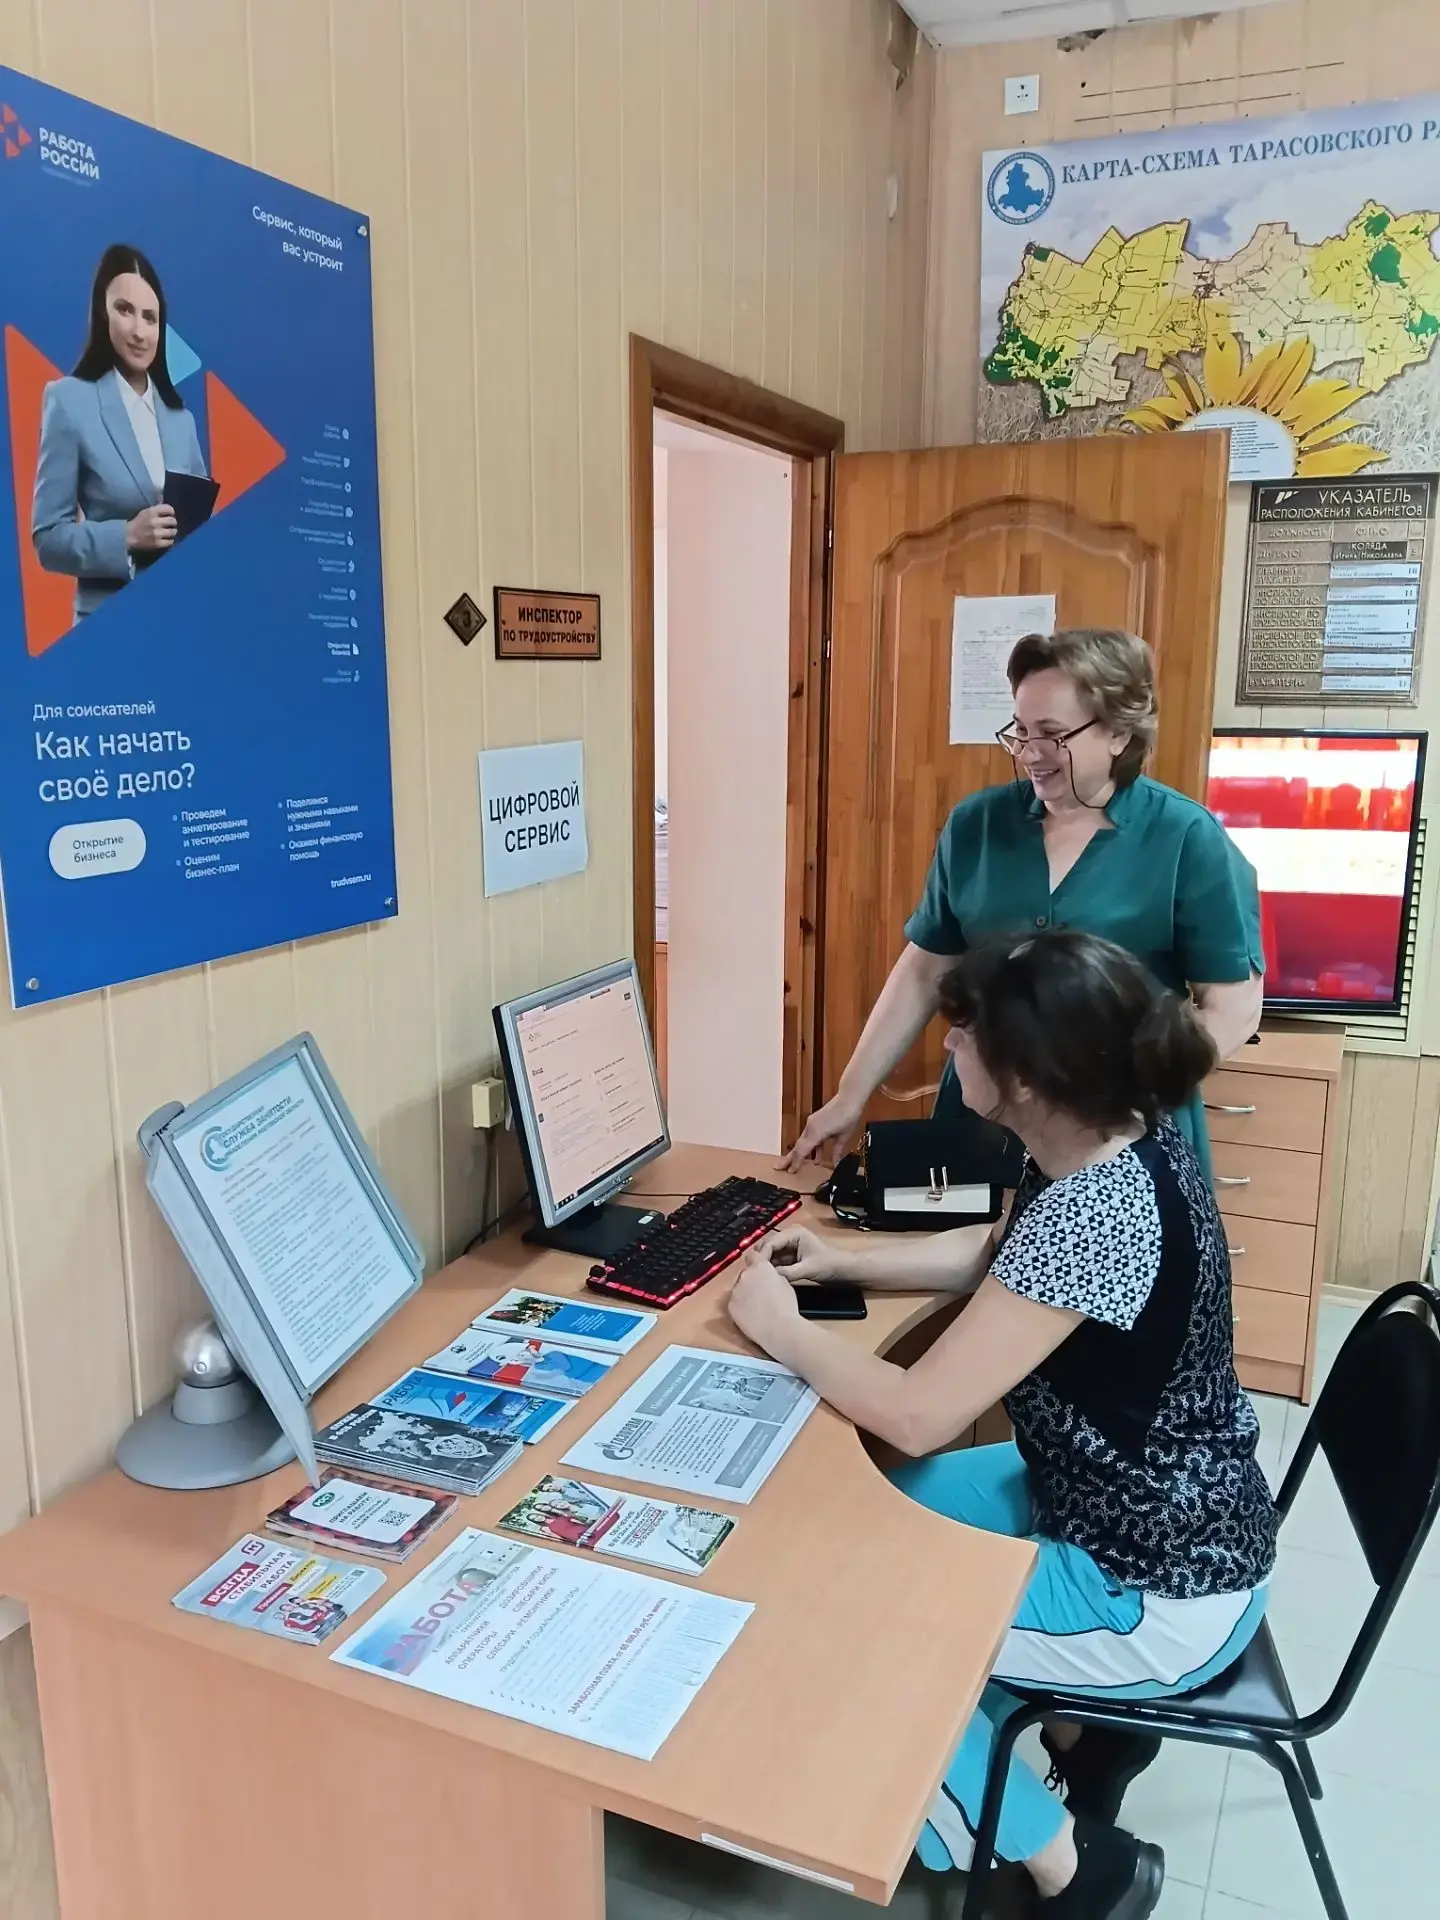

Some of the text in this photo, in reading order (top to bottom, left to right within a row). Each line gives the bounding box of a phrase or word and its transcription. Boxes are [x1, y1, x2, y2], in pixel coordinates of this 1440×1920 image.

[39, 127, 96, 162] РАБОТА
[1061, 148, 1220, 185] КАРТА-СХЕМА
[1229, 122, 1413, 164] ТАРАСОВСКОГО
[40, 145, 100, 180] РОССИИ
[252, 205, 343, 251] Сервис, который
[282, 242, 343, 272] вас устроит
[1261, 505, 1422, 519] РАСПОЛОЖЕНИЯ КАБИНЕТОВ
[1319, 488, 1411, 504] УКАЗАТЕЛЬ
[517, 606, 583, 625] ИНСПЕКТОР
[503, 629, 596, 644] ПО ТРУДОУСТРОЙСТВУ
[33, 700, 156, 721] Для соискателей
[35, 729, 191, 760] Как начать
[38, 763, 196, 802] своё дело?
[181, 808, 227, 822] Проведем
[488, 781, 580, 824] ЦИФРОВОЙ
[72, 834, 124, 850] Открытие
[182, 819, 248, 834] анкетирование
[183, 832, 250, 848] и тестирование
[294, 820, 331, 832] знаниями
[505, 819, 570, 853] СЕРВИС
[73, 847, 117, 863] бизнеса
[184, 853, 220, 867] Оценим
[185, 862, 240, 879] бизнес-план
[223, 1096, 292, 1148] СЛУЖБА ЗАНЯТОСТИ
[382, 1374, 426, 1407] РАБОТА
[609, 1417, 644, 1450] ГАЗПРОМ
[205, 1565, 254, 1603] ВСЕГДА
[227, 1550, 287, 1601] СТАБИЛЬНАЯ
[259, 1558, 296, 1589] РАБОТА
[443, 1619, 491, 1665] АППАРАТЧИКИ
[497, 1564, 544, 1609] ДОЗИРОВЩИКИ
[457, 1629, 499, 1670] ОПЕРАТОРЫ
[510, 1584, 542, 1613] СЛЕСАРИ
[484, 1628, 519, 1660] СЛЕСАРИ
[514, 1586, 557, 1627] РЕМОНТНИКИ
[566, 1674, 605, 1715] ЗАРАБОТНАЯ
[597, 1655, 619, 1676] ПЛАТА
